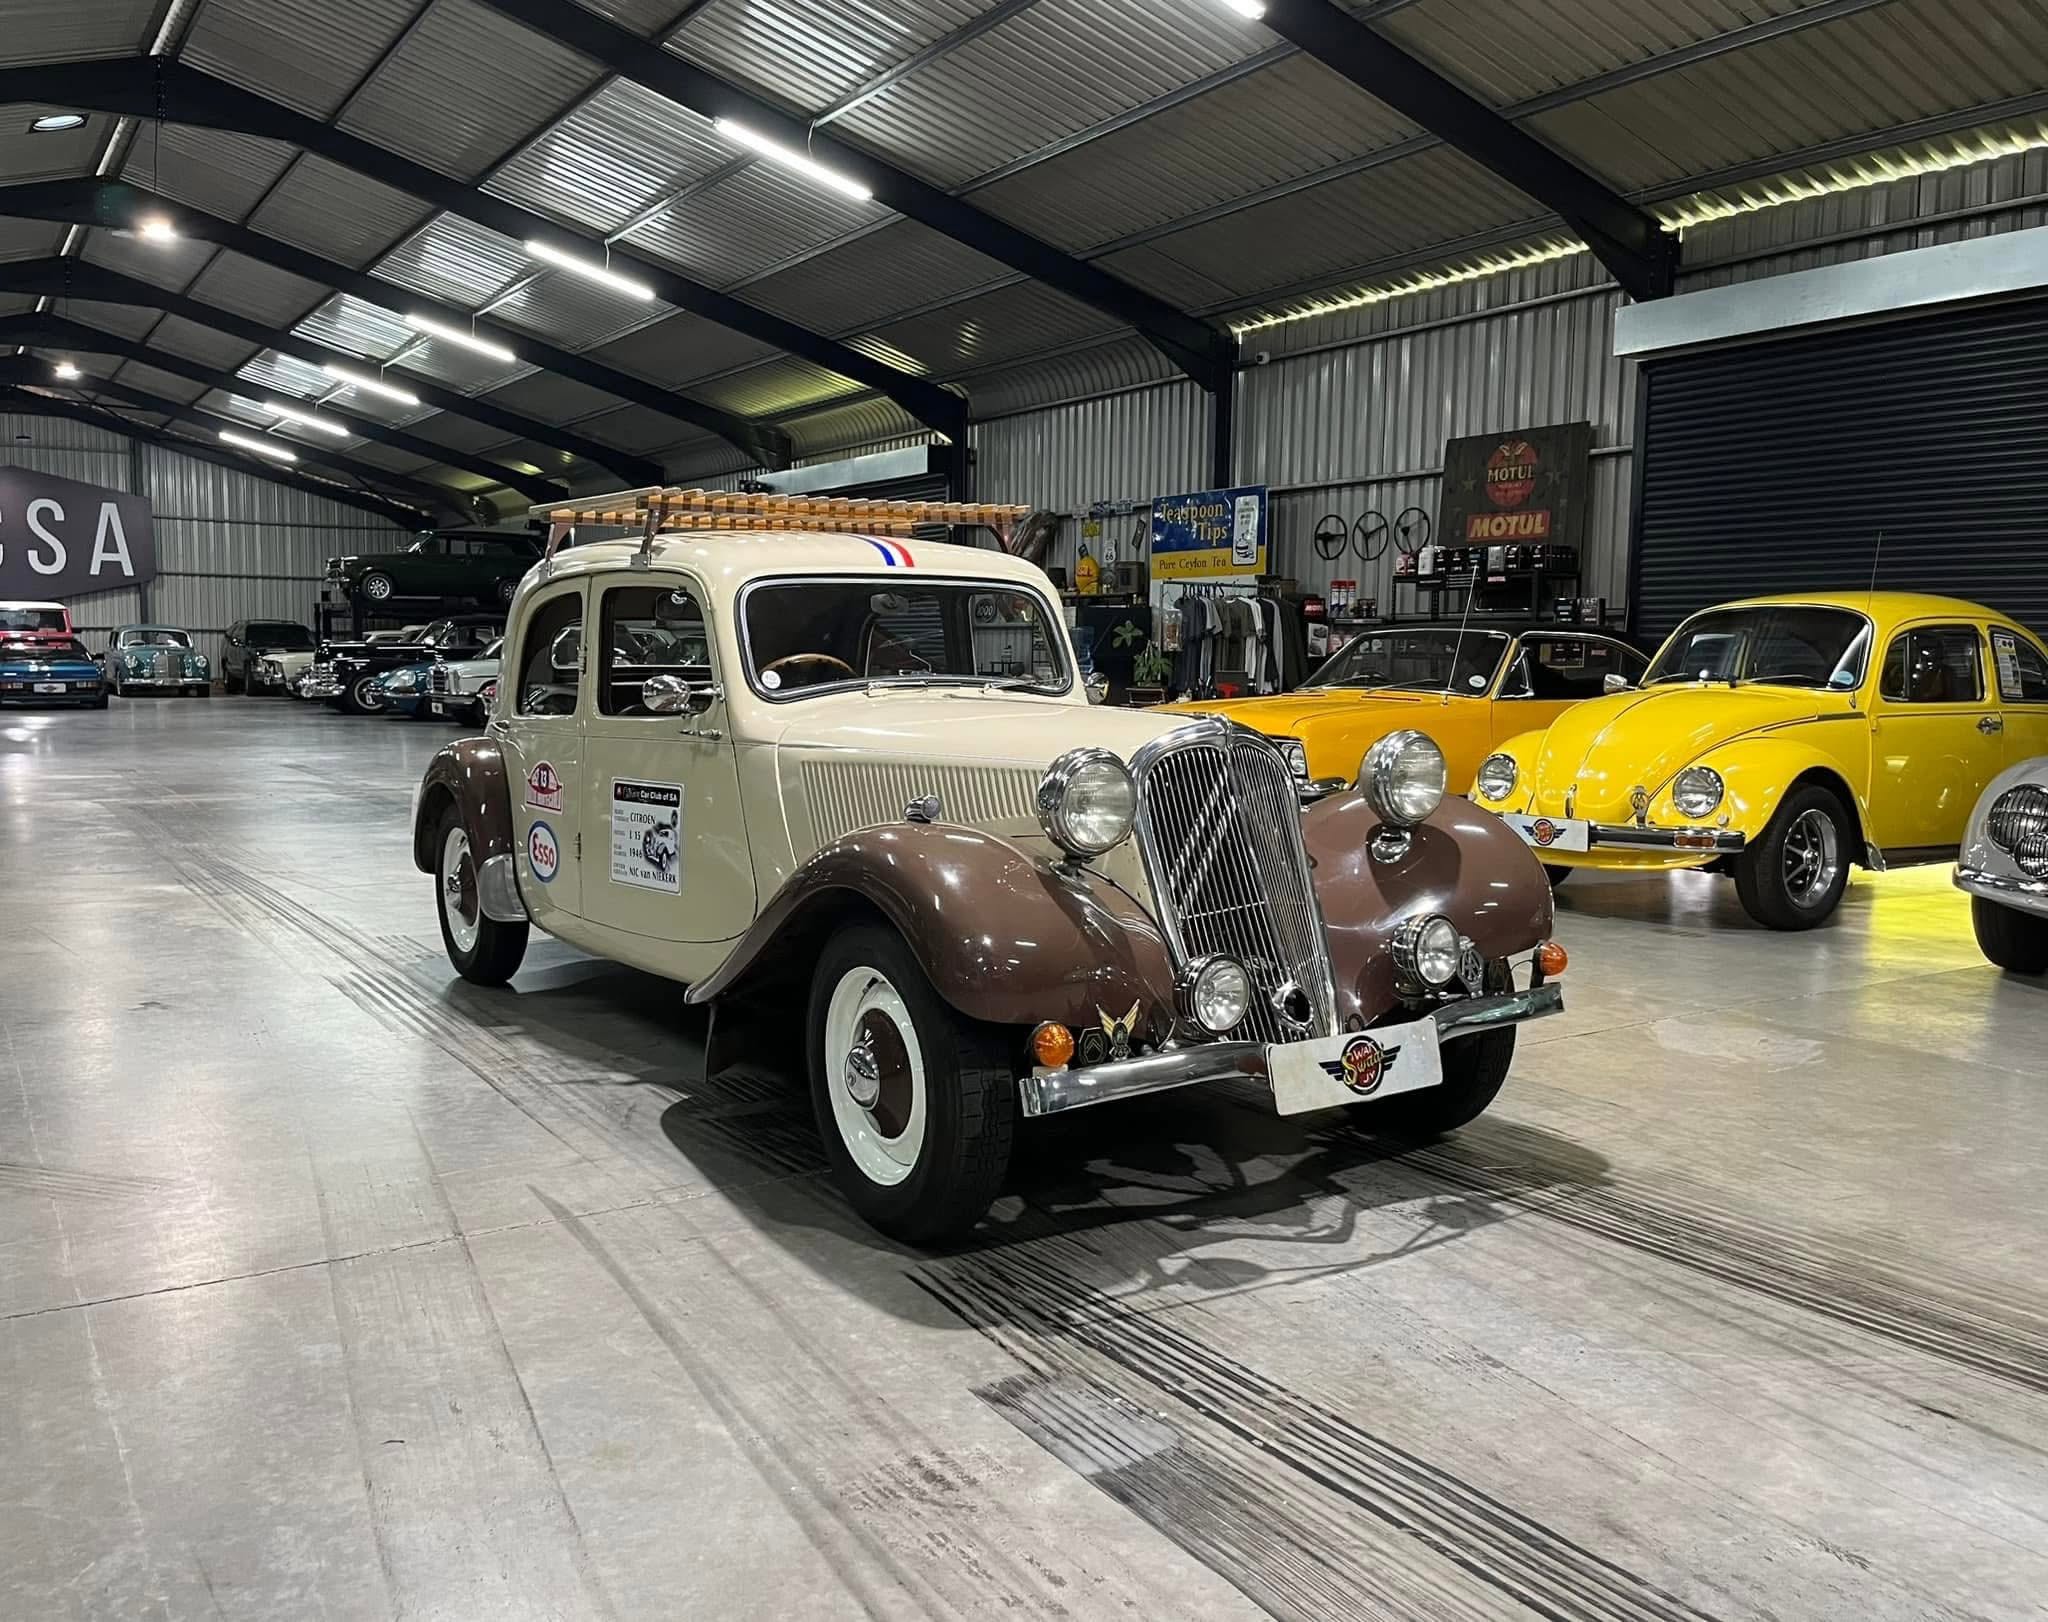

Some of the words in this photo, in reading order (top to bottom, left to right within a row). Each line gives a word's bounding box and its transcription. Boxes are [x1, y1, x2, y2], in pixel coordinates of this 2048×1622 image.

[1487, 464, 1533, 483] MOTUL
[1160, 502, 1223, 523] Teaspoon
[0, 497, 136, 577] SA
[1198, 521, 1228, 547] Tips
[1469, 513, 1545, 538] MOTUL
[1159, 559, 1176, 570] Pure
[1179, 557, 1207, 571] Ceylon
[1211, 556, 1226, 567] Tea
